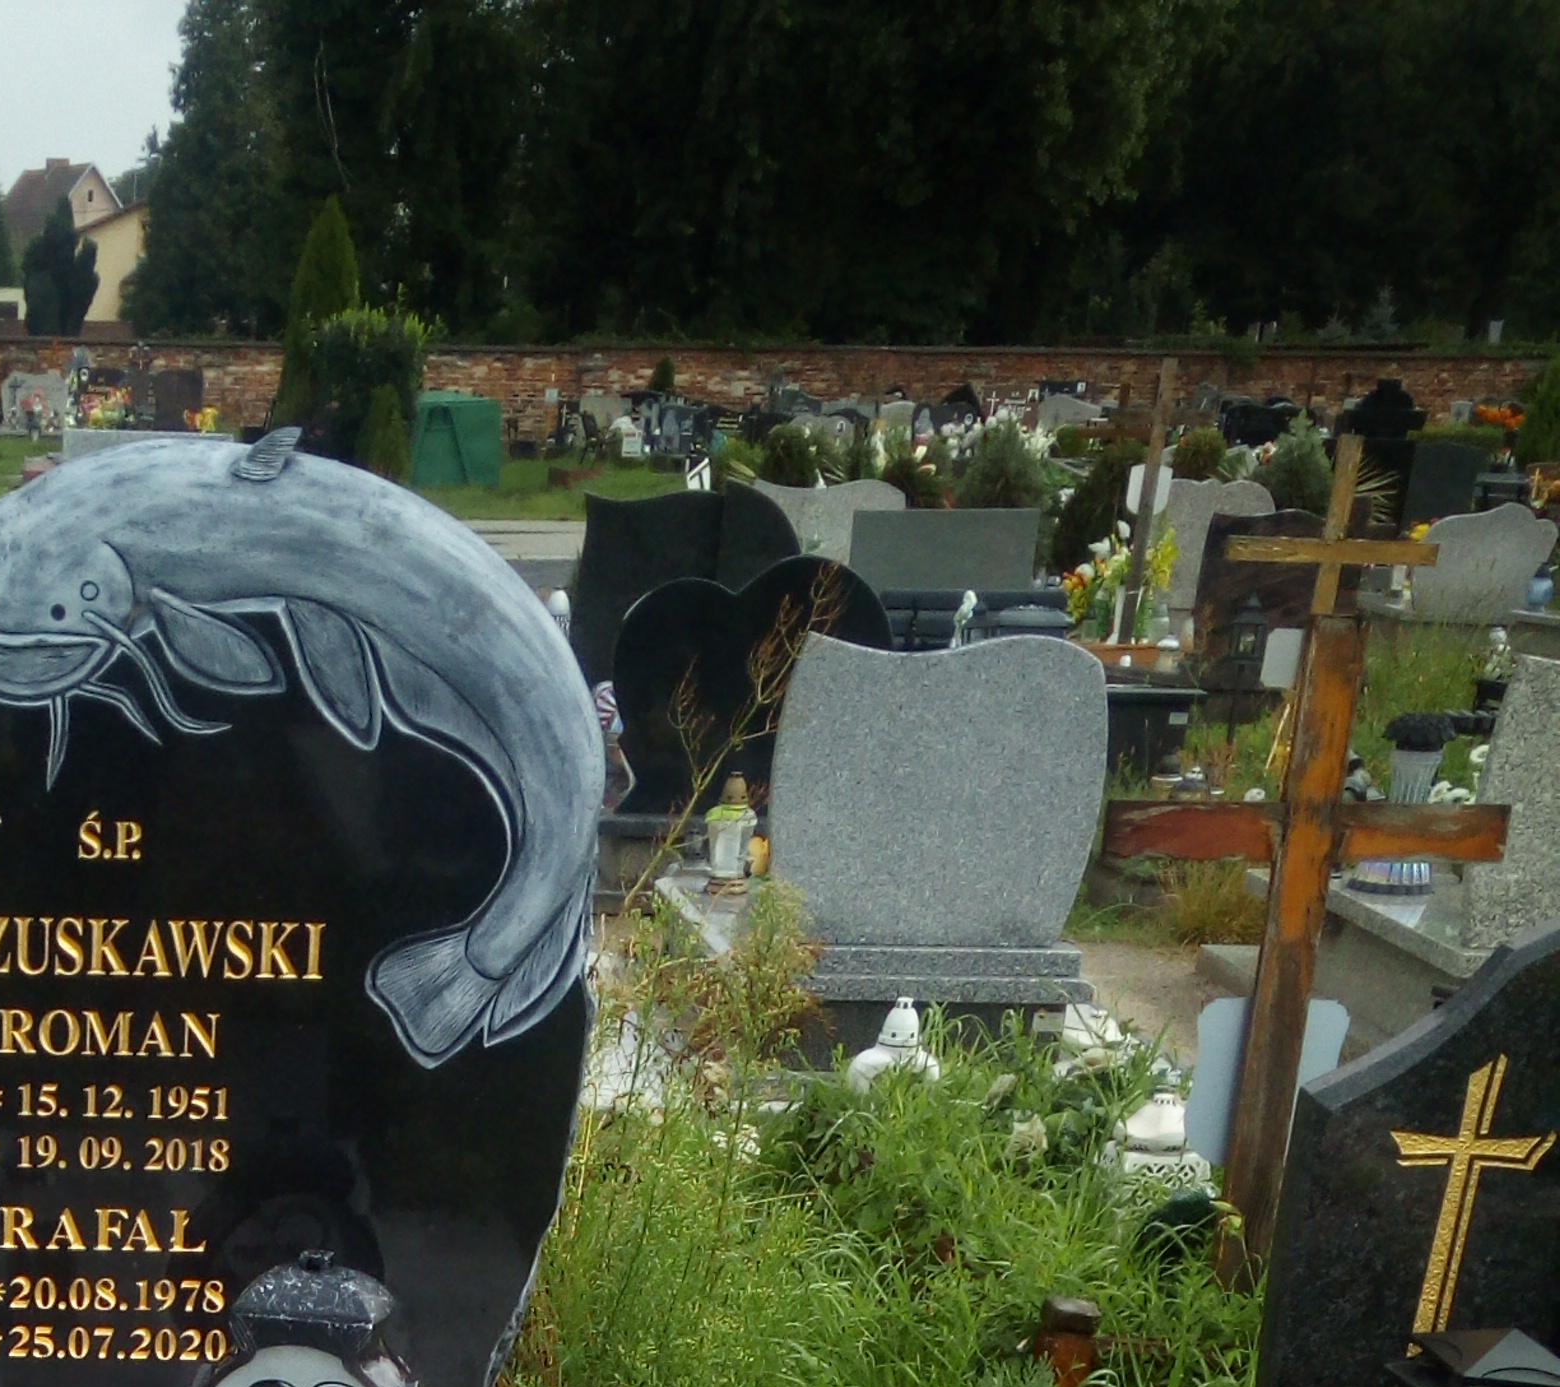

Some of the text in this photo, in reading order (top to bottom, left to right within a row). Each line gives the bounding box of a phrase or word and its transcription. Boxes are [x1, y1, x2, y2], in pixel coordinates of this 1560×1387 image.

[77, 810, 142, 860] Ś.P.
[17, 1083, 230, 1121] 15. 12. 1951
[17, 1135, 231, 1173] 19. 09. 2018
[0, 1206, 207, 1253] RAFAŁ
